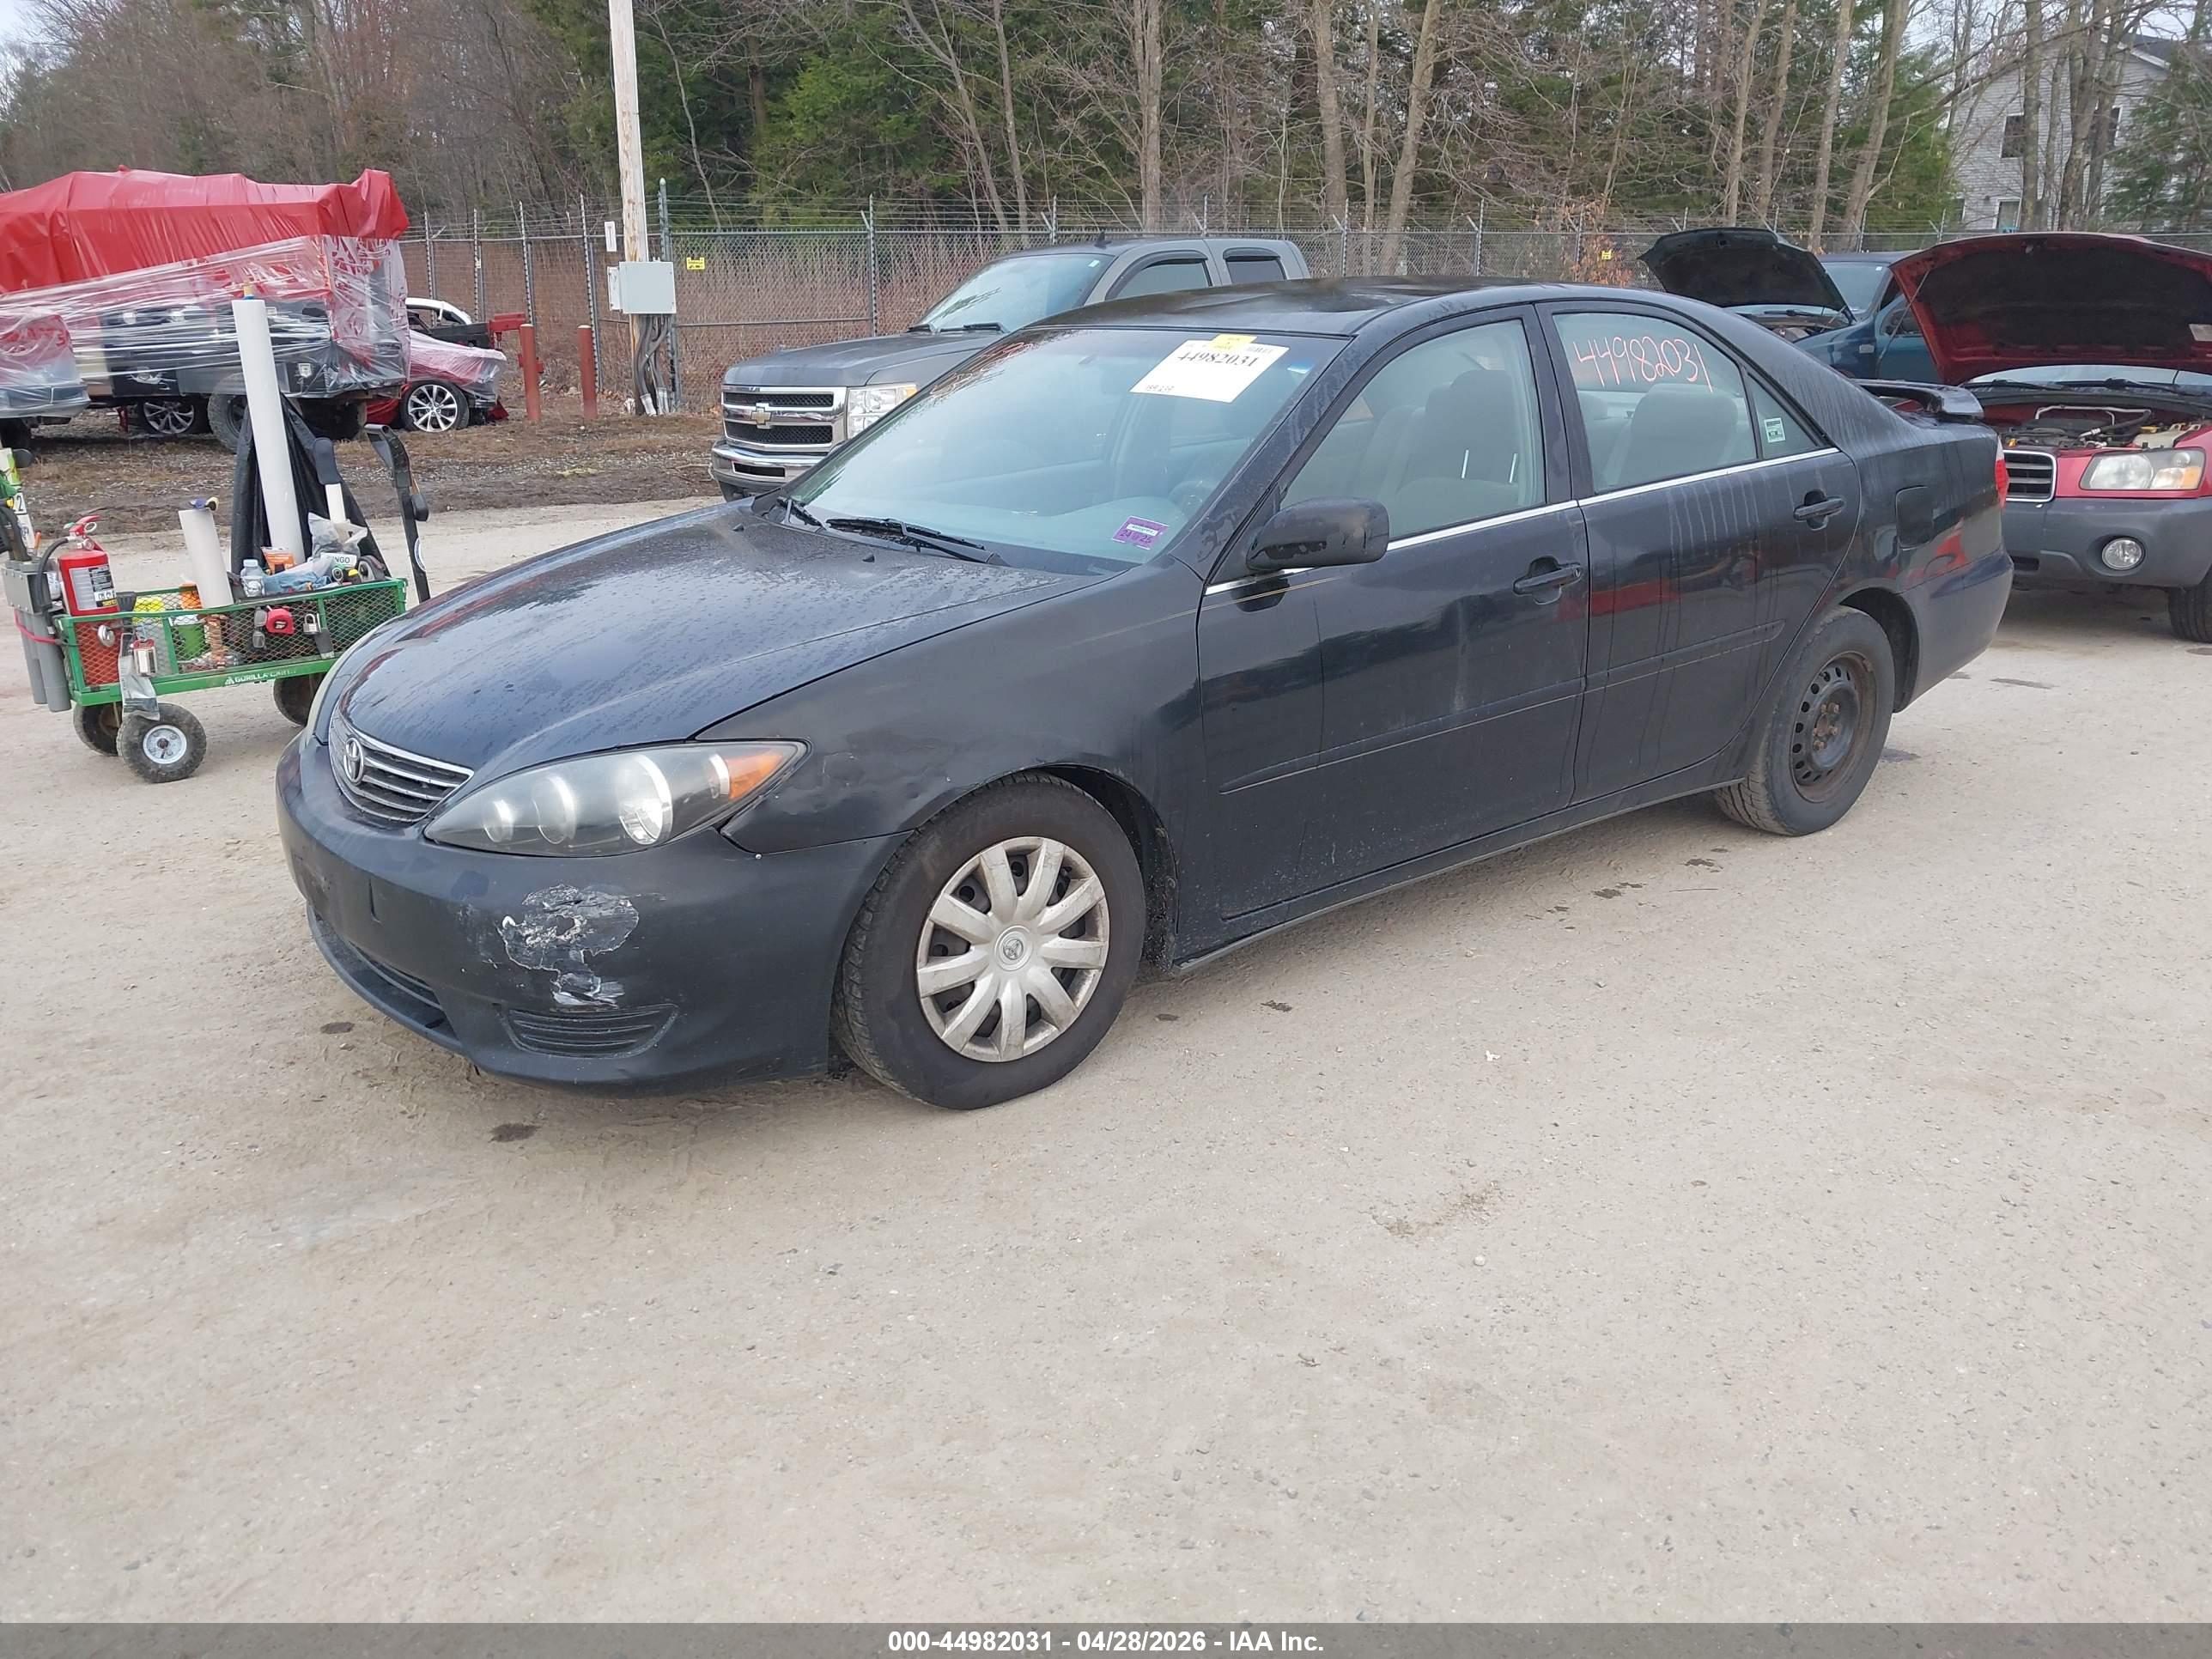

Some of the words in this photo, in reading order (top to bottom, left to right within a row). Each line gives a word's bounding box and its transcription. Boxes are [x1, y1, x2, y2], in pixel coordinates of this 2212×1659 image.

[1177, 350, 1260, 368] 44982031
[1573, 336, 1714, 392] 44982031
[333, 556, 350, 564] NGO
[234, 672, 269, 683] GORILLA
